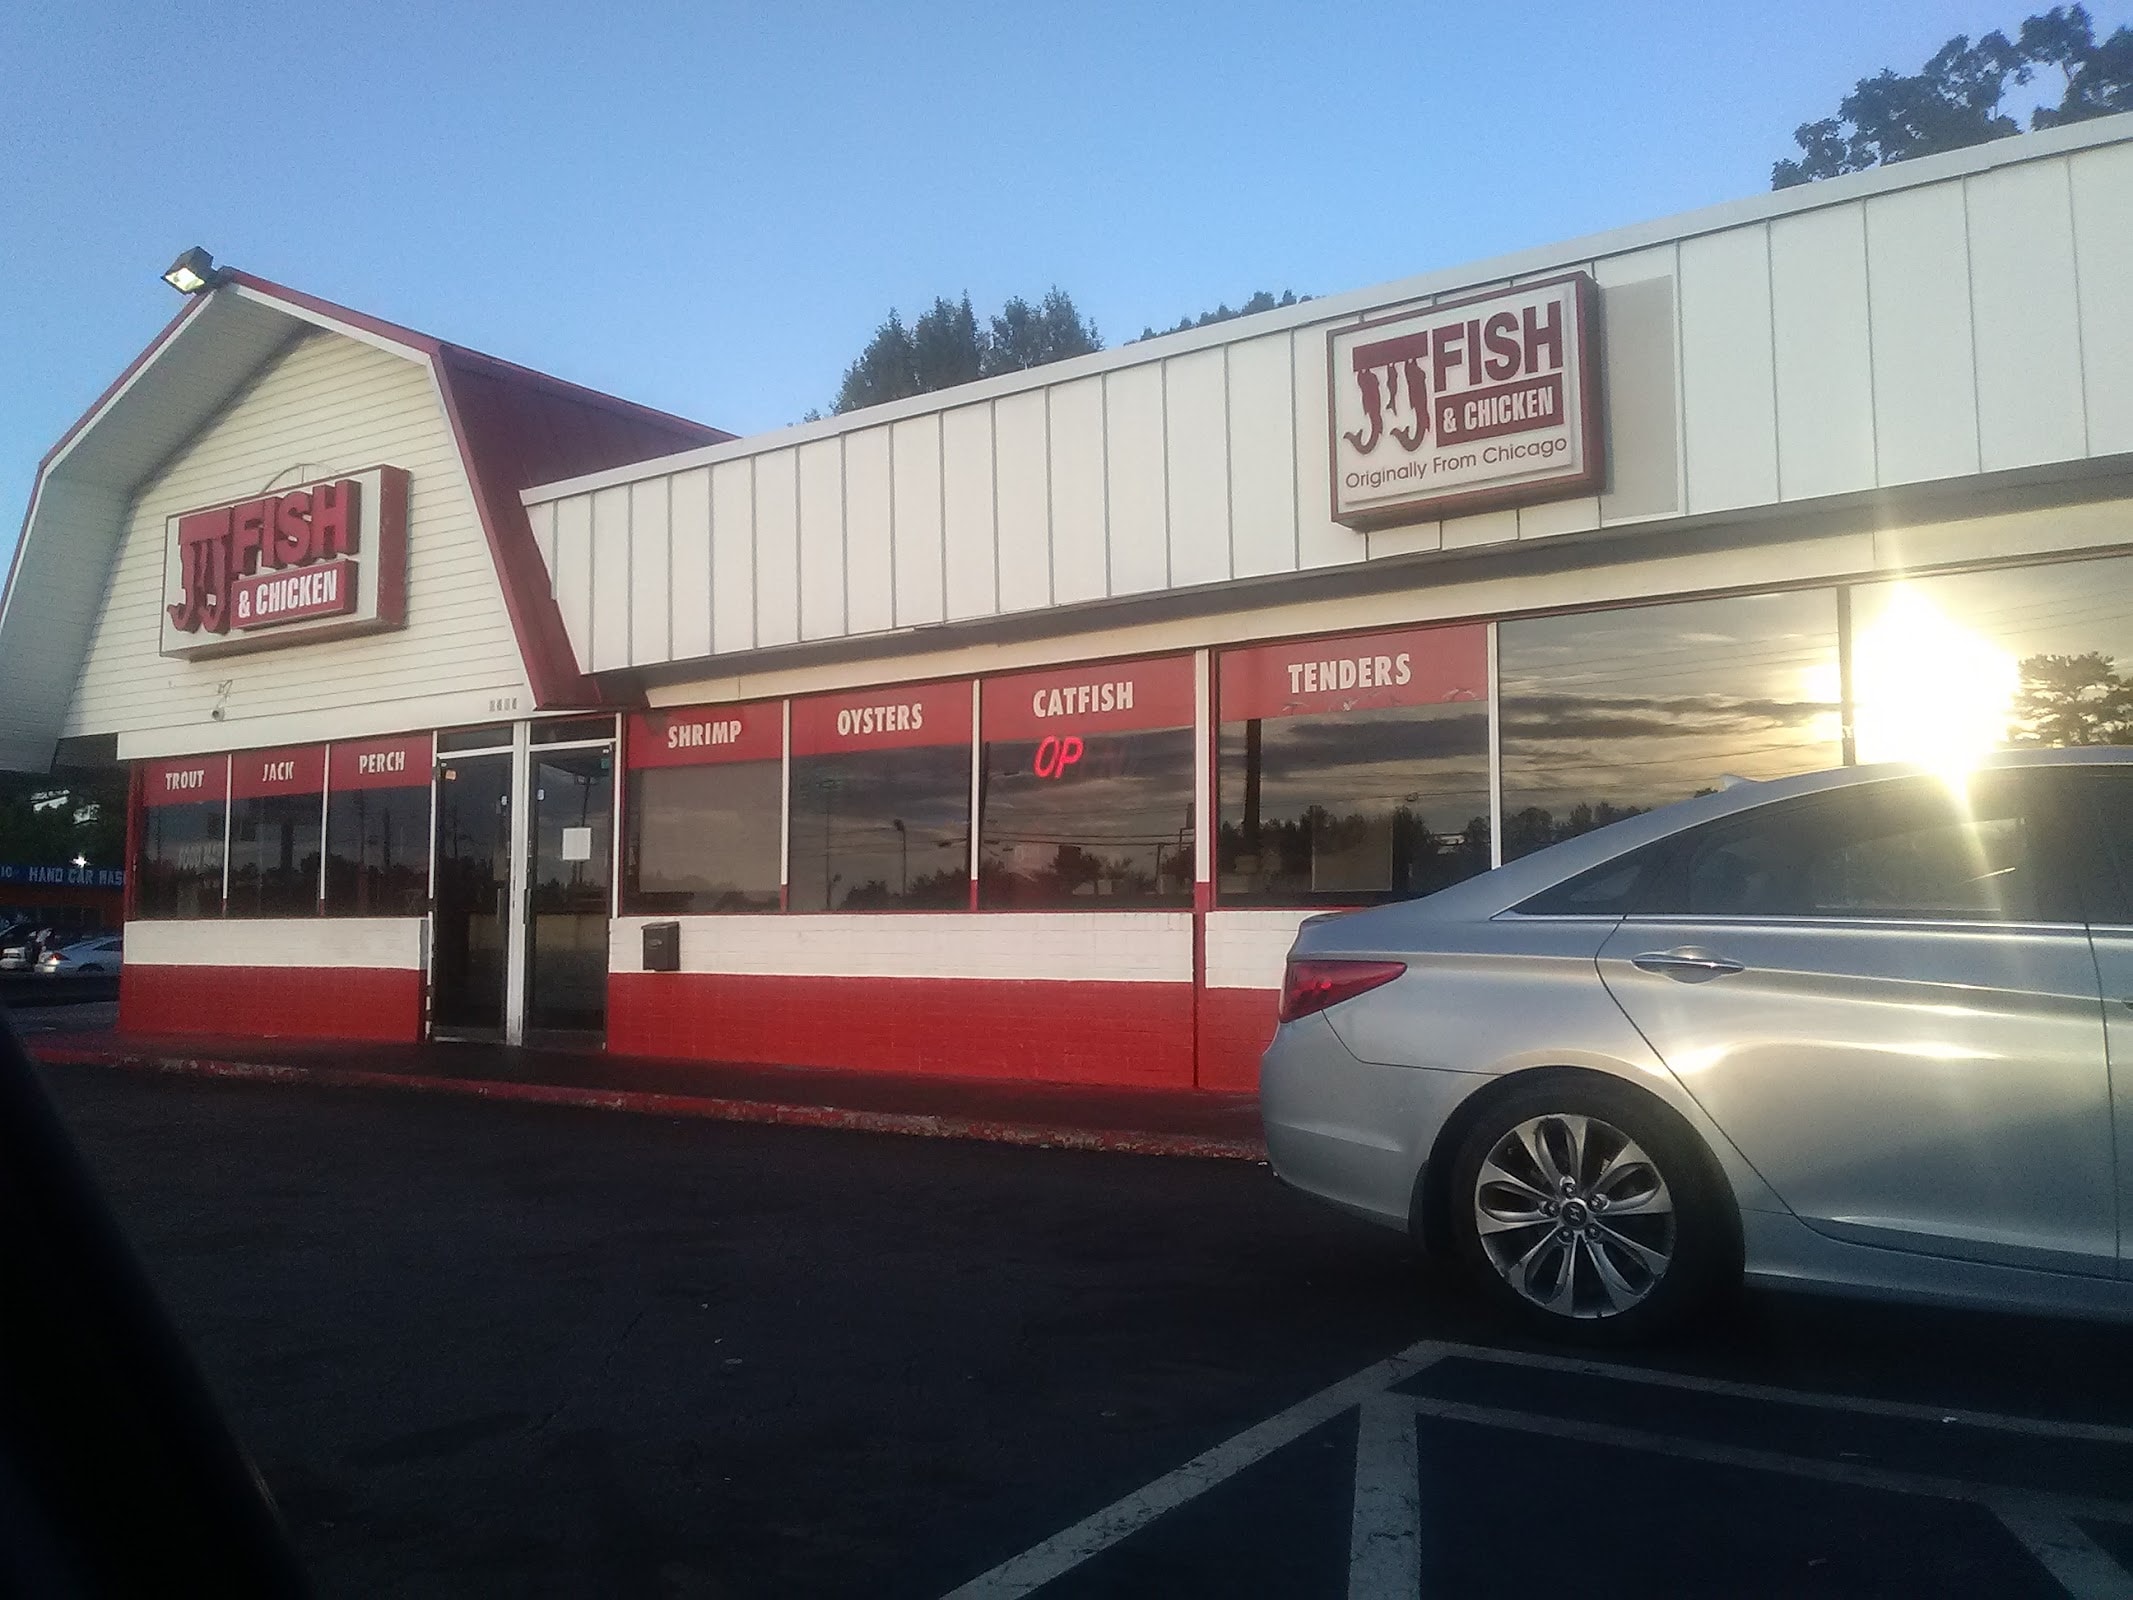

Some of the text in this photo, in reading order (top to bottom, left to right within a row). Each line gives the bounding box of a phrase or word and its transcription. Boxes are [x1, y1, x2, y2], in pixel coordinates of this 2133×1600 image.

[1343, 300, 1564, 455] JJ FISH
[1442, 386, 1554, 434] & CHICKEN
[1345, 437, 1568, 490] Originally From Chicago
[232, 479, 361, 577] FISH
[237, 568, 338, 619] & CHICKEN
[1287, 653, 1413, 694] TENDERS
[1032, 681, 1134, 718] CATFISH
[667, 720, 743, 749] SHRIMP
[836, 702, 923, 736] OYSTERS
[165, 769, 205, 791] TROUT
[262, 761, 295, 782] JACK
[358, 751, 406, 775] PERCH
[67, 868, 94, 885] CAR
